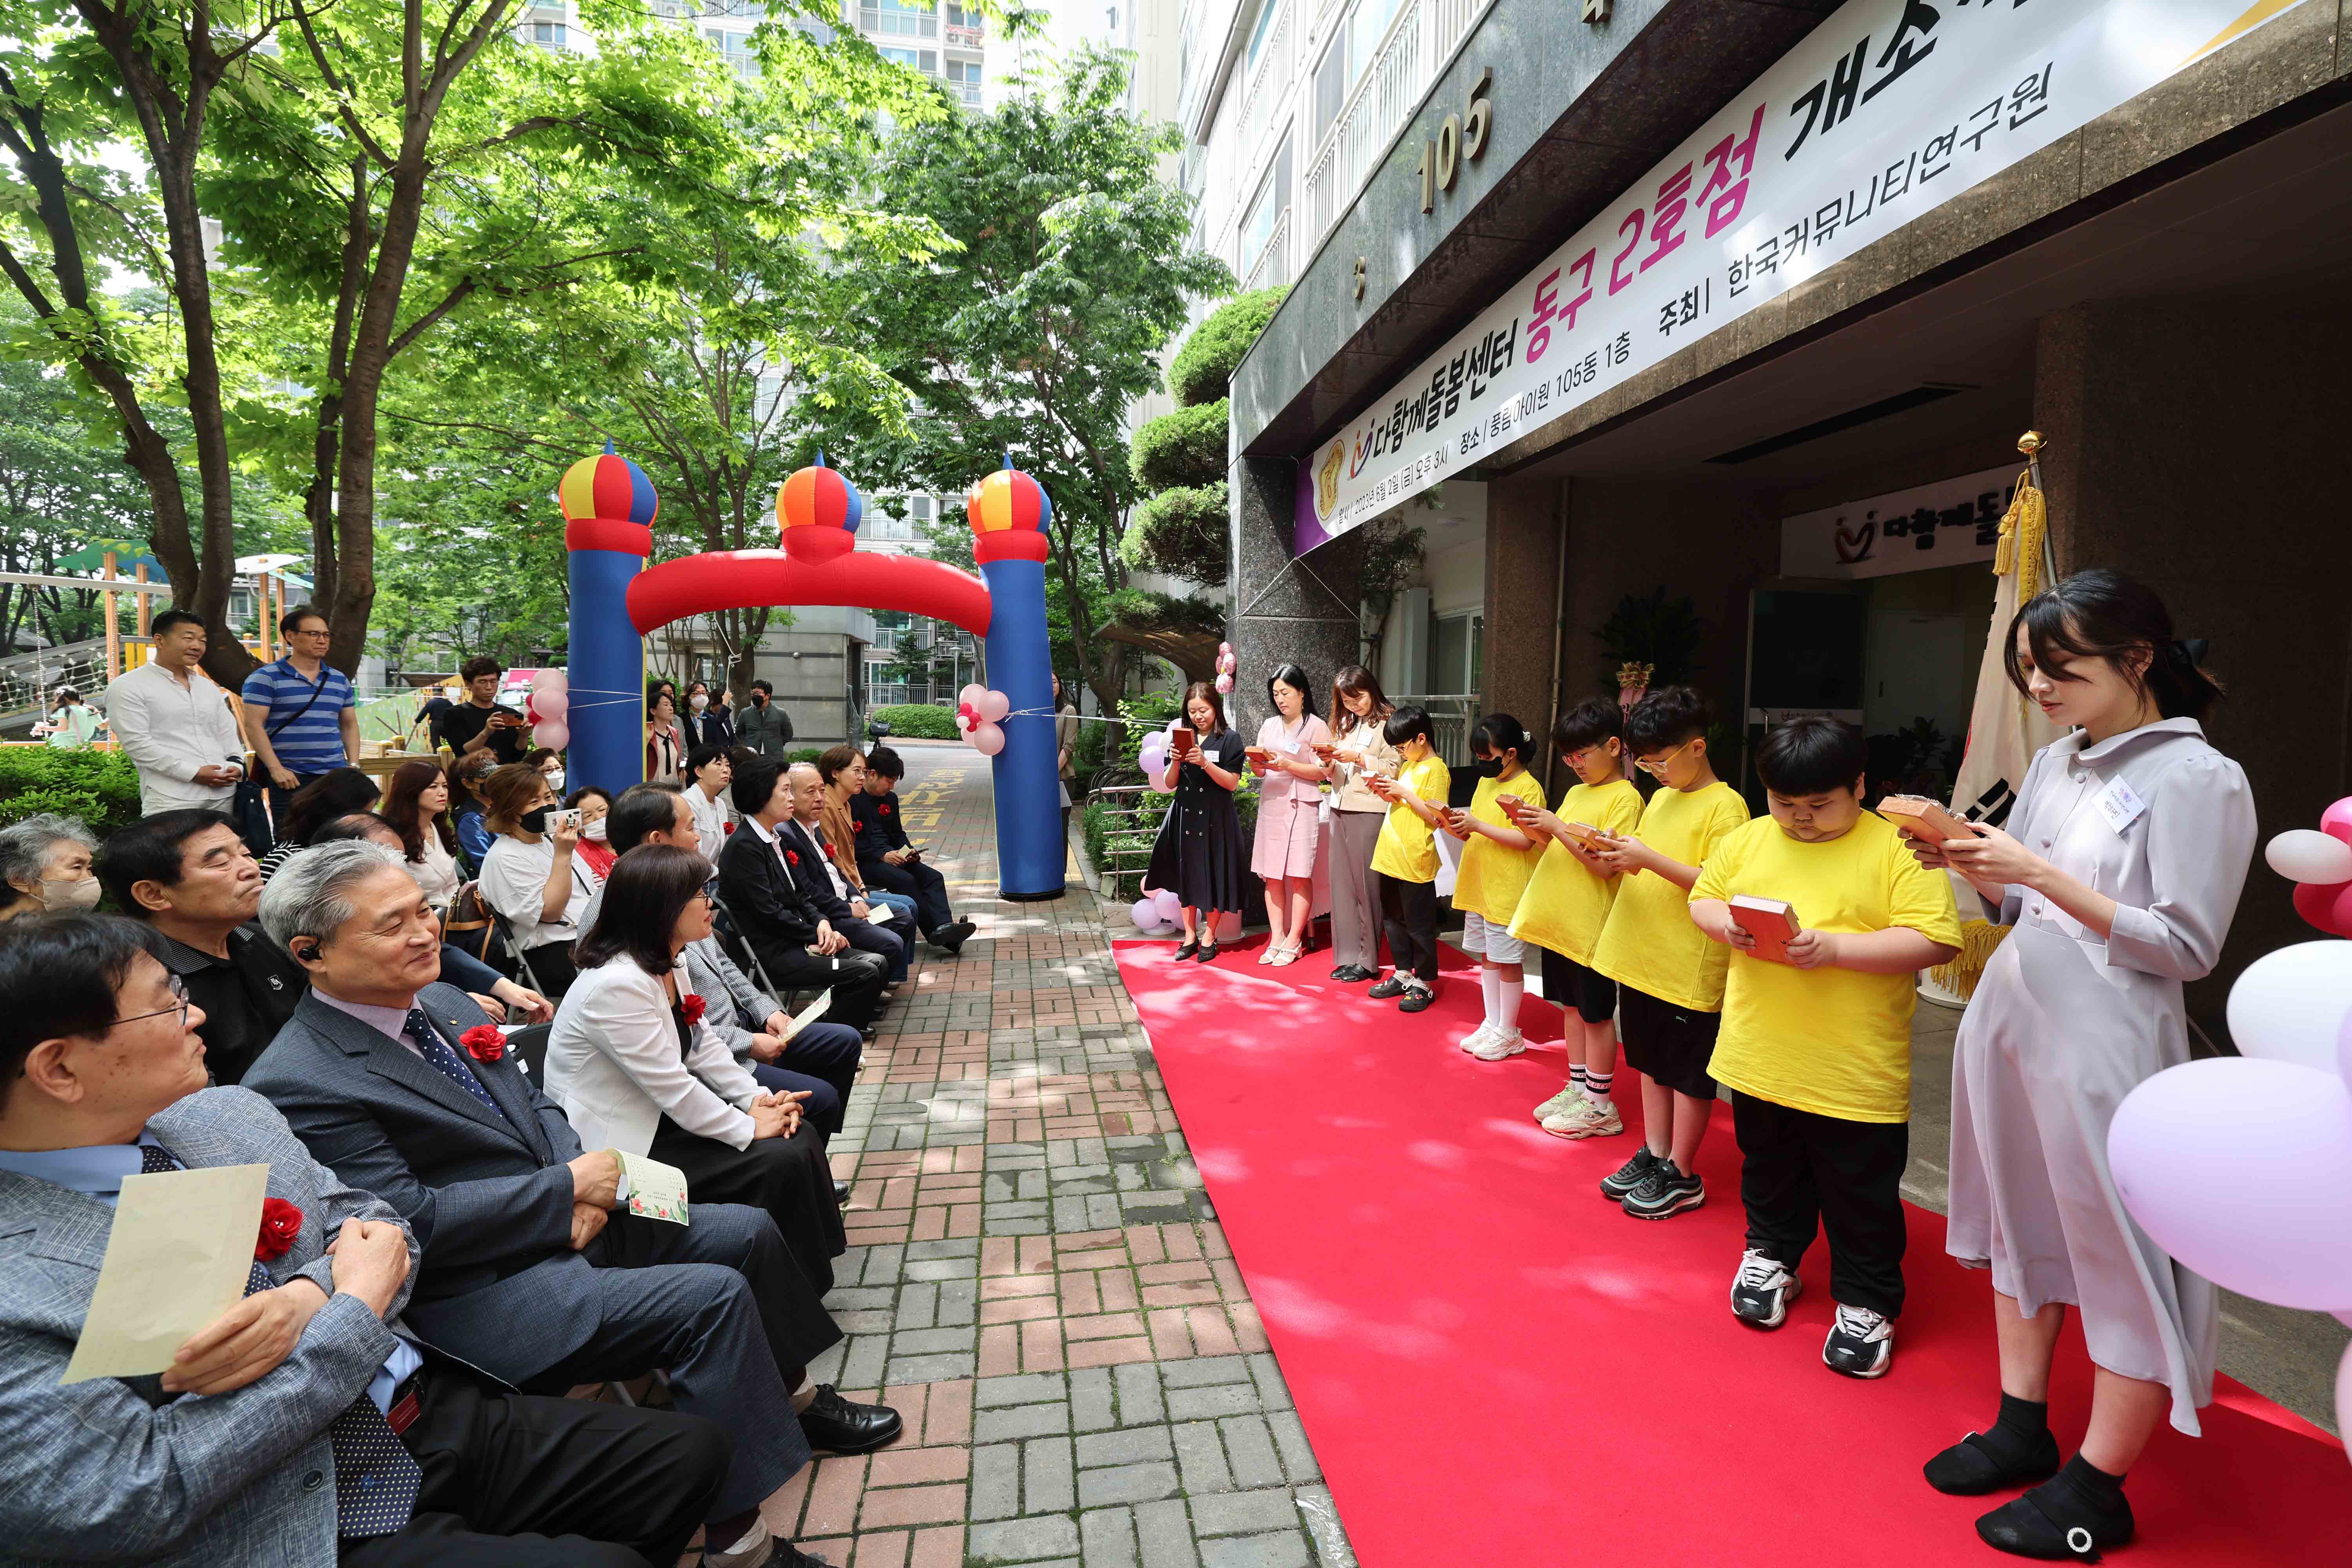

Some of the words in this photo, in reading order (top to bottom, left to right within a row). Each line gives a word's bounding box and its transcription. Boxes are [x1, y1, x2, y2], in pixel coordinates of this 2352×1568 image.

[1353, 256, 1365, 299] 3
[1355, 489, 1374, 515] 2023년
[1376, 482, 1387, 502] 6월
[1388, 473, 1399, 495] 2일
[1401, 464, 1413, 490] (금)
[1416, 455, 1432, 480] 오후
[1434, 443, 1448, 469] 3시
[1490, 380, 1550, 438] 풍림아이원
[1556, 350, 1597, 397] 105동
[1605, 330, 1630, 368] 1층
[1728, 61, 2054, 298] 한국커뮤니티연구원
[1373, 317, 1519, 458] 다함께돌봄센터
[1526, 247, 1596, 364] 동구
[1608, 101, 1767, 296] 2호점
[1784, 0, 2029, 162] 개소
[1417, 66, 1493, 214] 105
